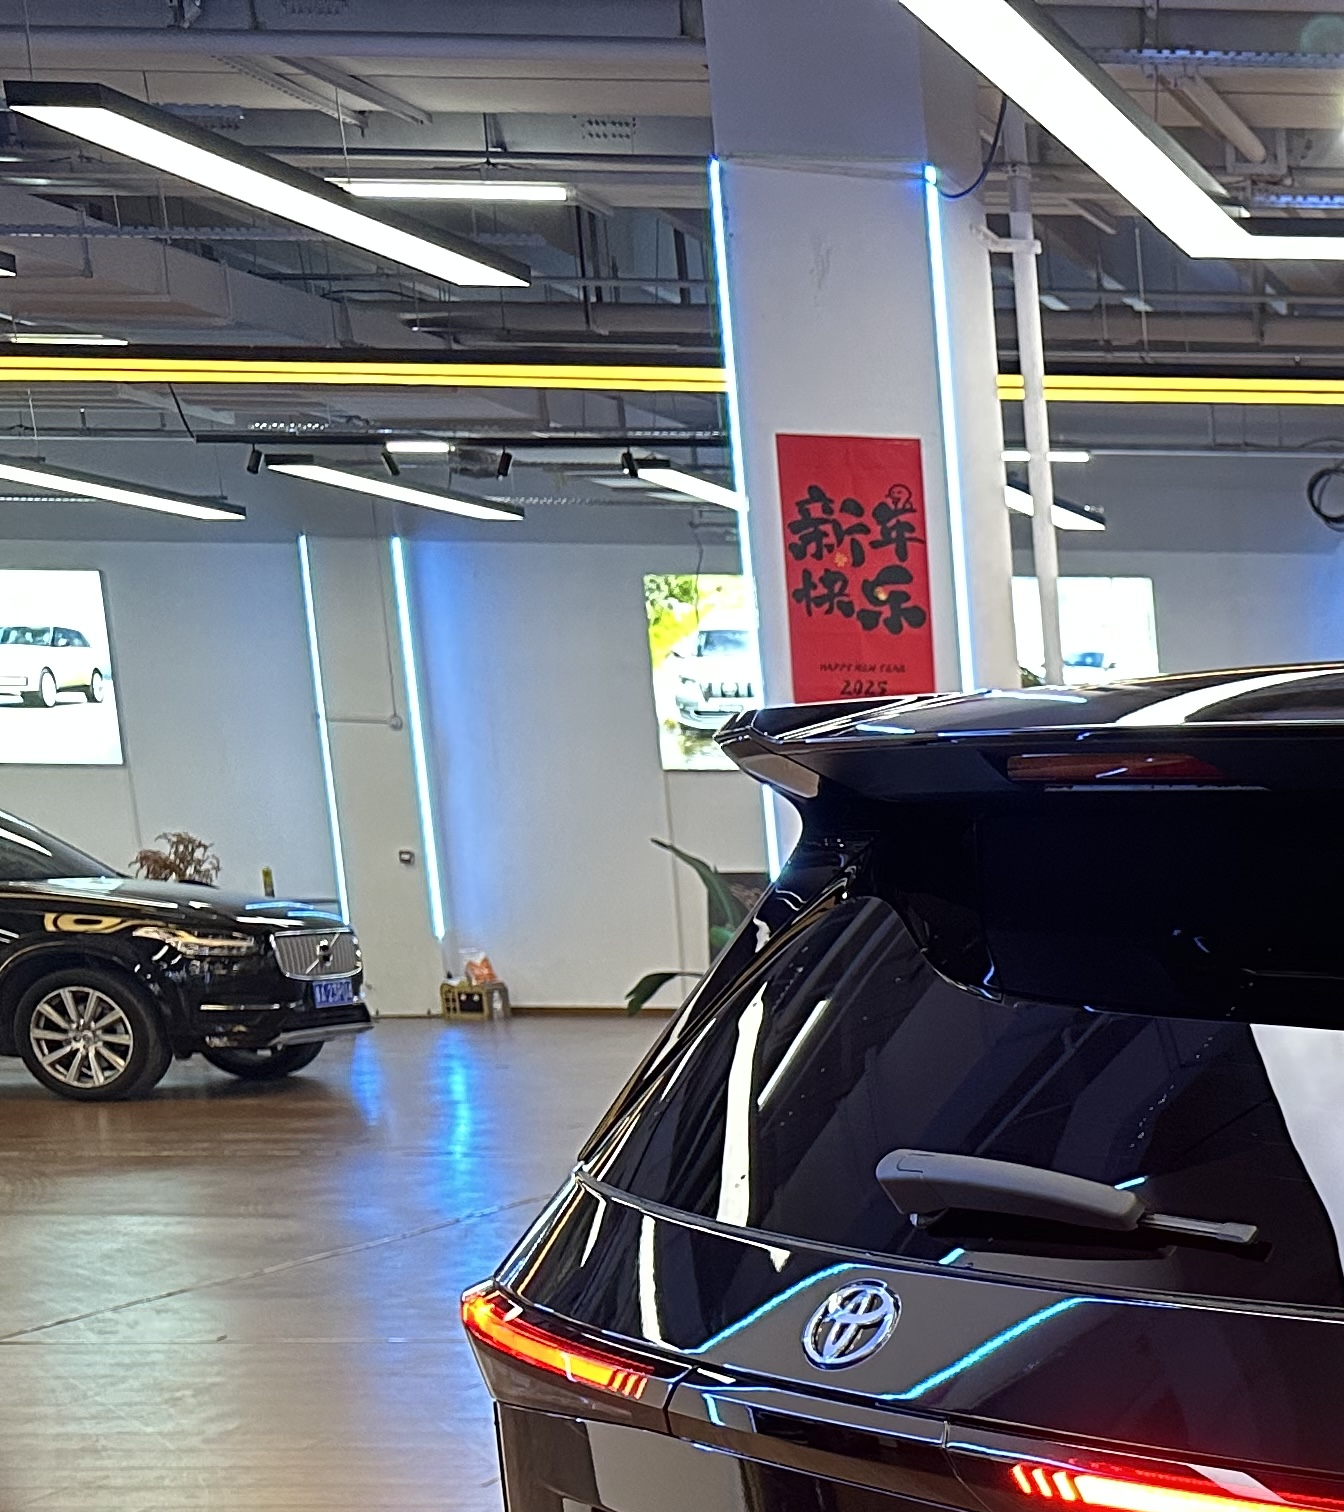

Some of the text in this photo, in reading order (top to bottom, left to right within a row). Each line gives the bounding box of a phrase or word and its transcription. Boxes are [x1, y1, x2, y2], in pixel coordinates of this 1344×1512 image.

[788, 484, 925, 567] 新年
[791, 564, 927, 635] 快乐
[839, 679, 888, 696] 2025
